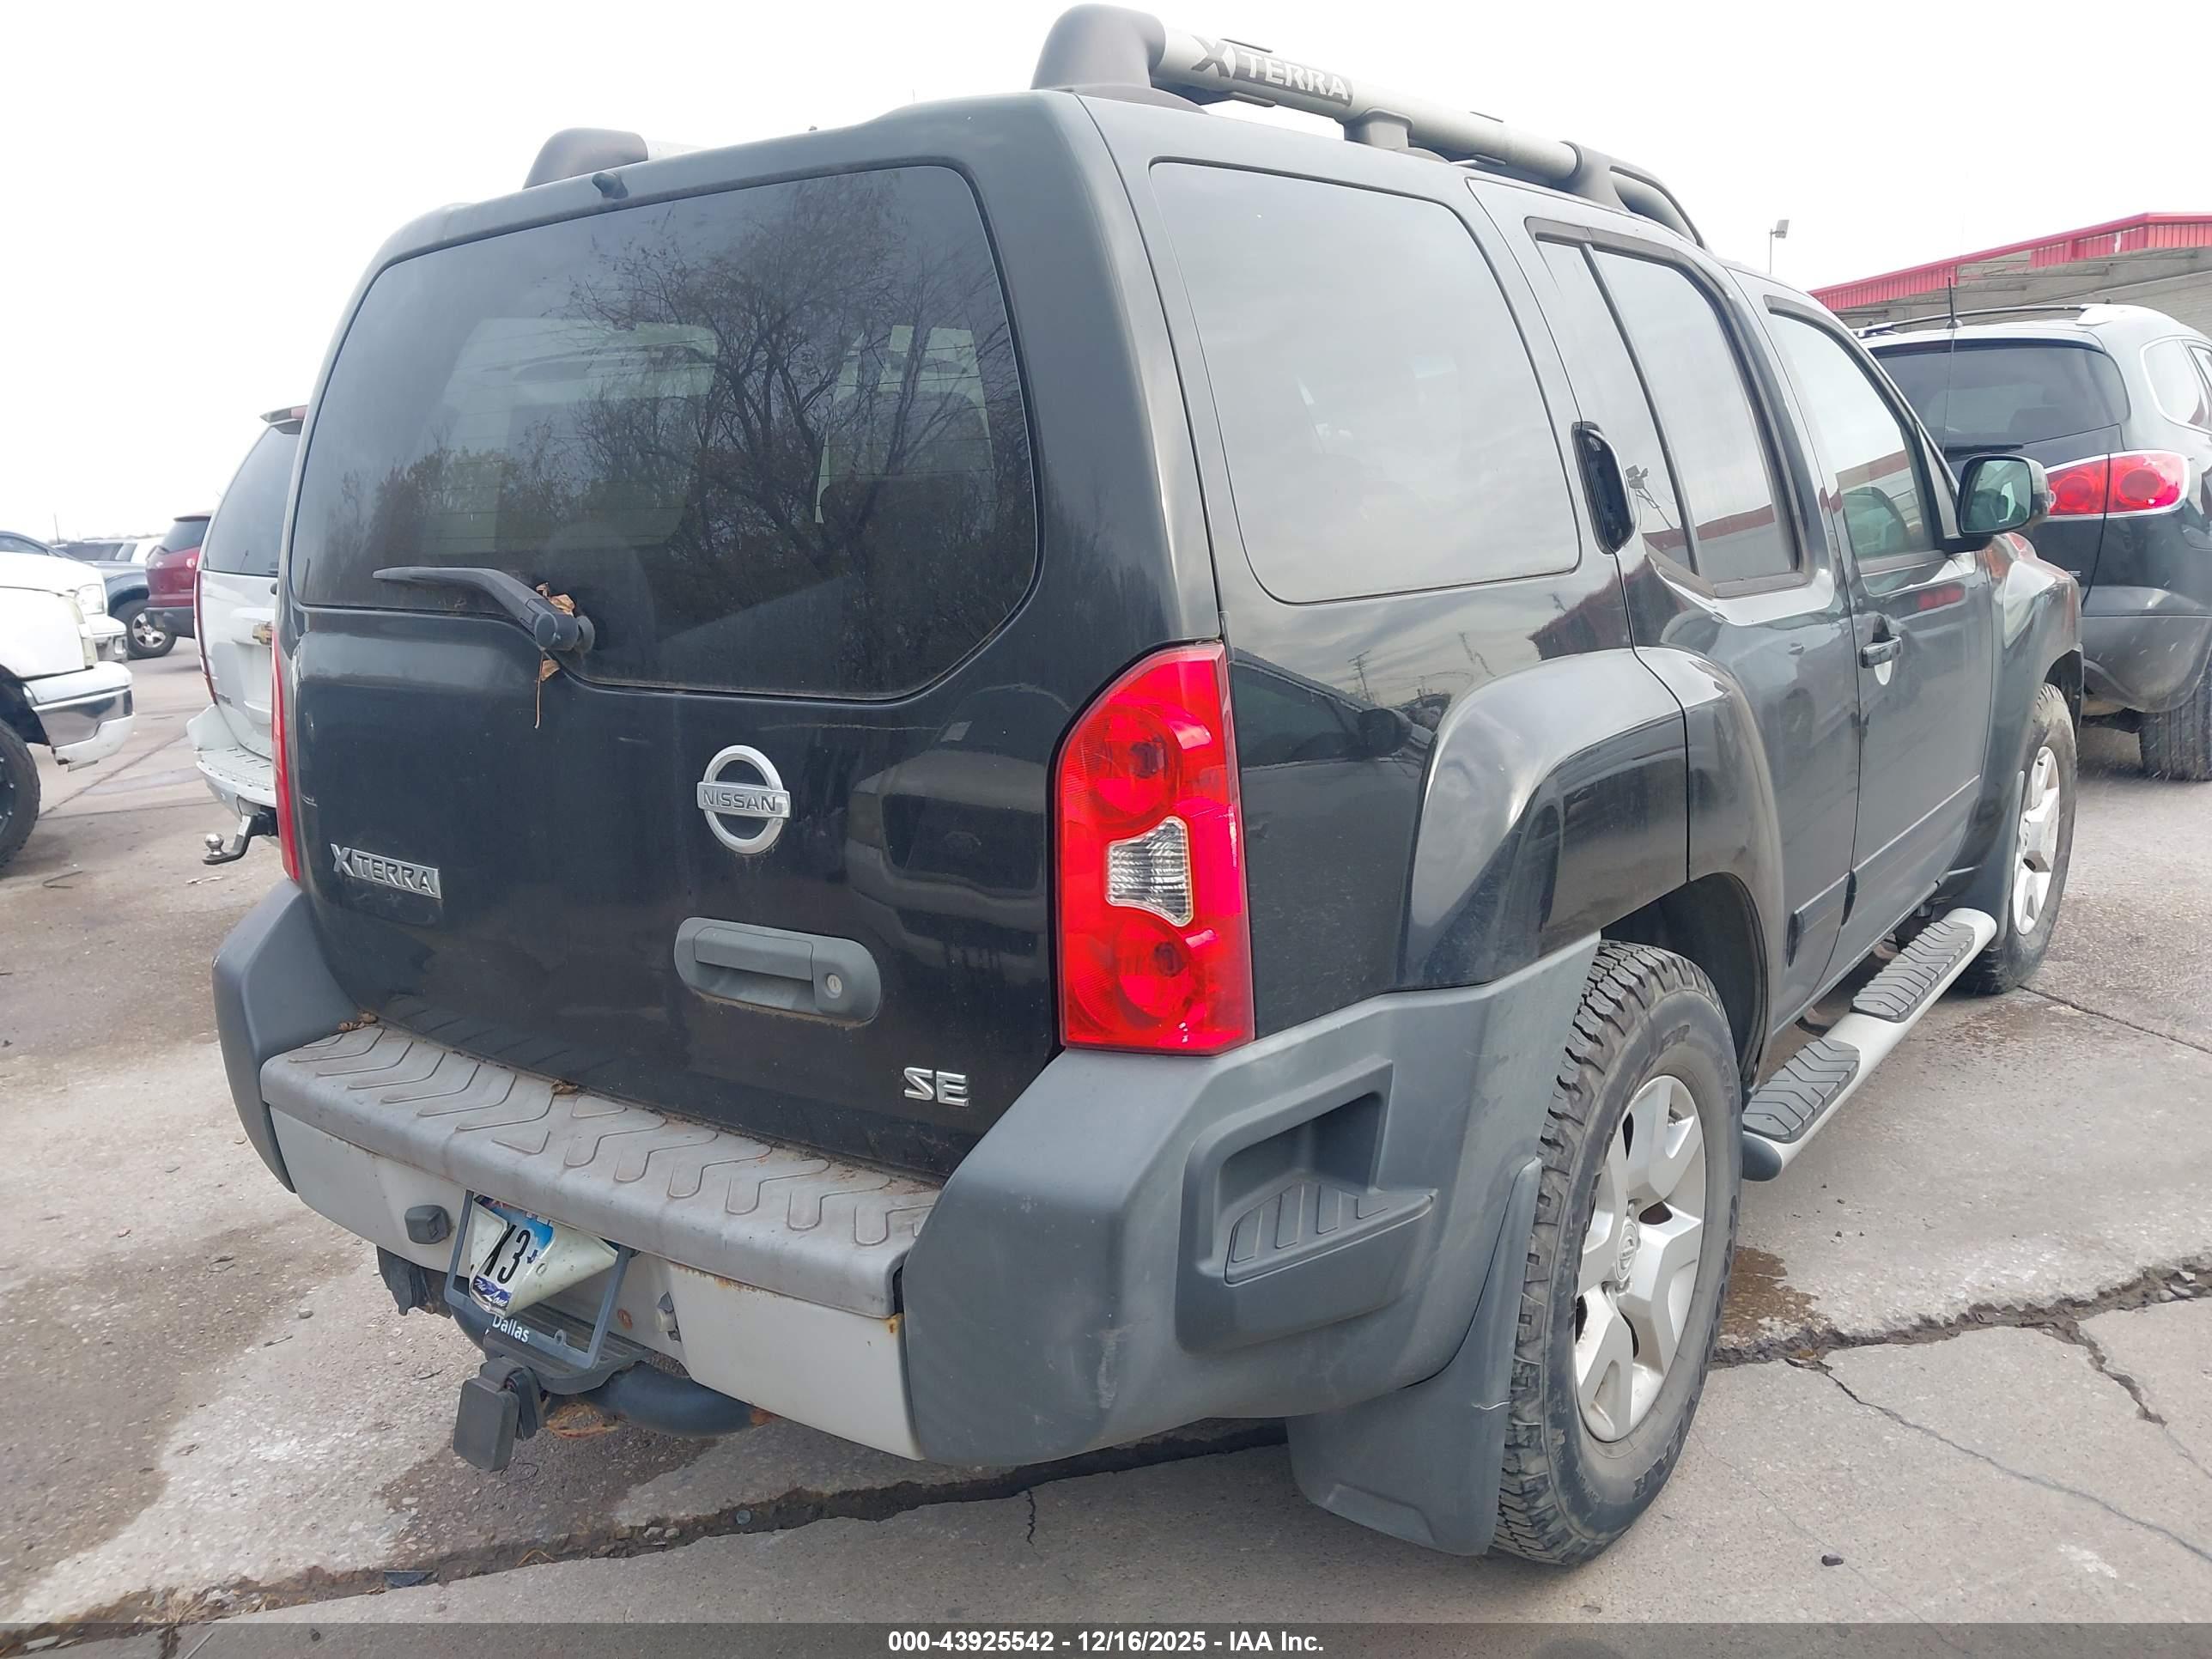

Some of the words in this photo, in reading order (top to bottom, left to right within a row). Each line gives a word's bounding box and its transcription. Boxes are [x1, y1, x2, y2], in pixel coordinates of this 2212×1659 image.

[1190, 34, 1350, 100] XTERRA
[702, 789, 776, 812] NISSAN
[330, 842, 437, 896] XTERRA
[903, 1066, 969, 1107] SE
[492, 1315, 530, 1343] Dallas
